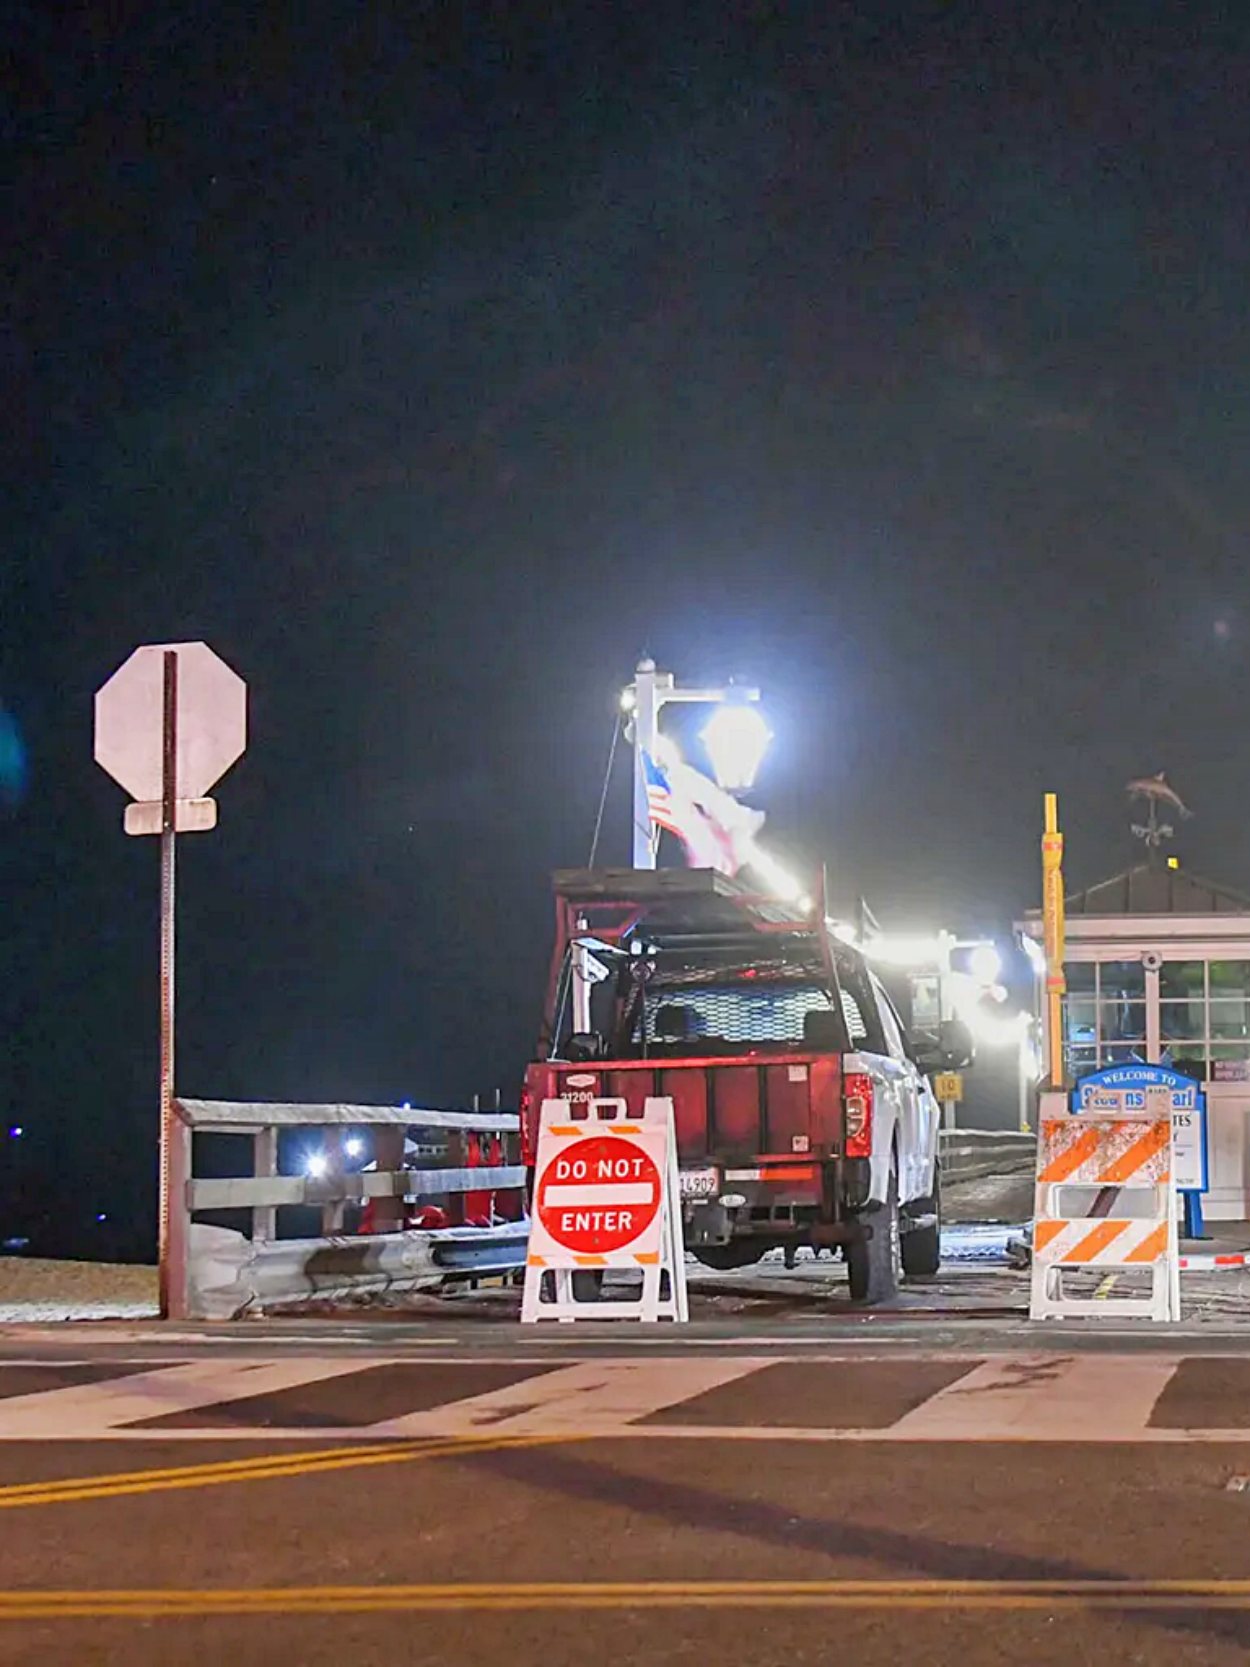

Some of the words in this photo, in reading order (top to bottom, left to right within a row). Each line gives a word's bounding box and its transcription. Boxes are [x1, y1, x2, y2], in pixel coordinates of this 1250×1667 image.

[1102, 1070, 1158, 1085] WELCOME
[1161, 1073, 1177, 1086] TO
[556, 1159, 587, 1179] DO
[598, 1158, 645, 1178] NOT
[561, 1212, 633, 1232] ENTER
